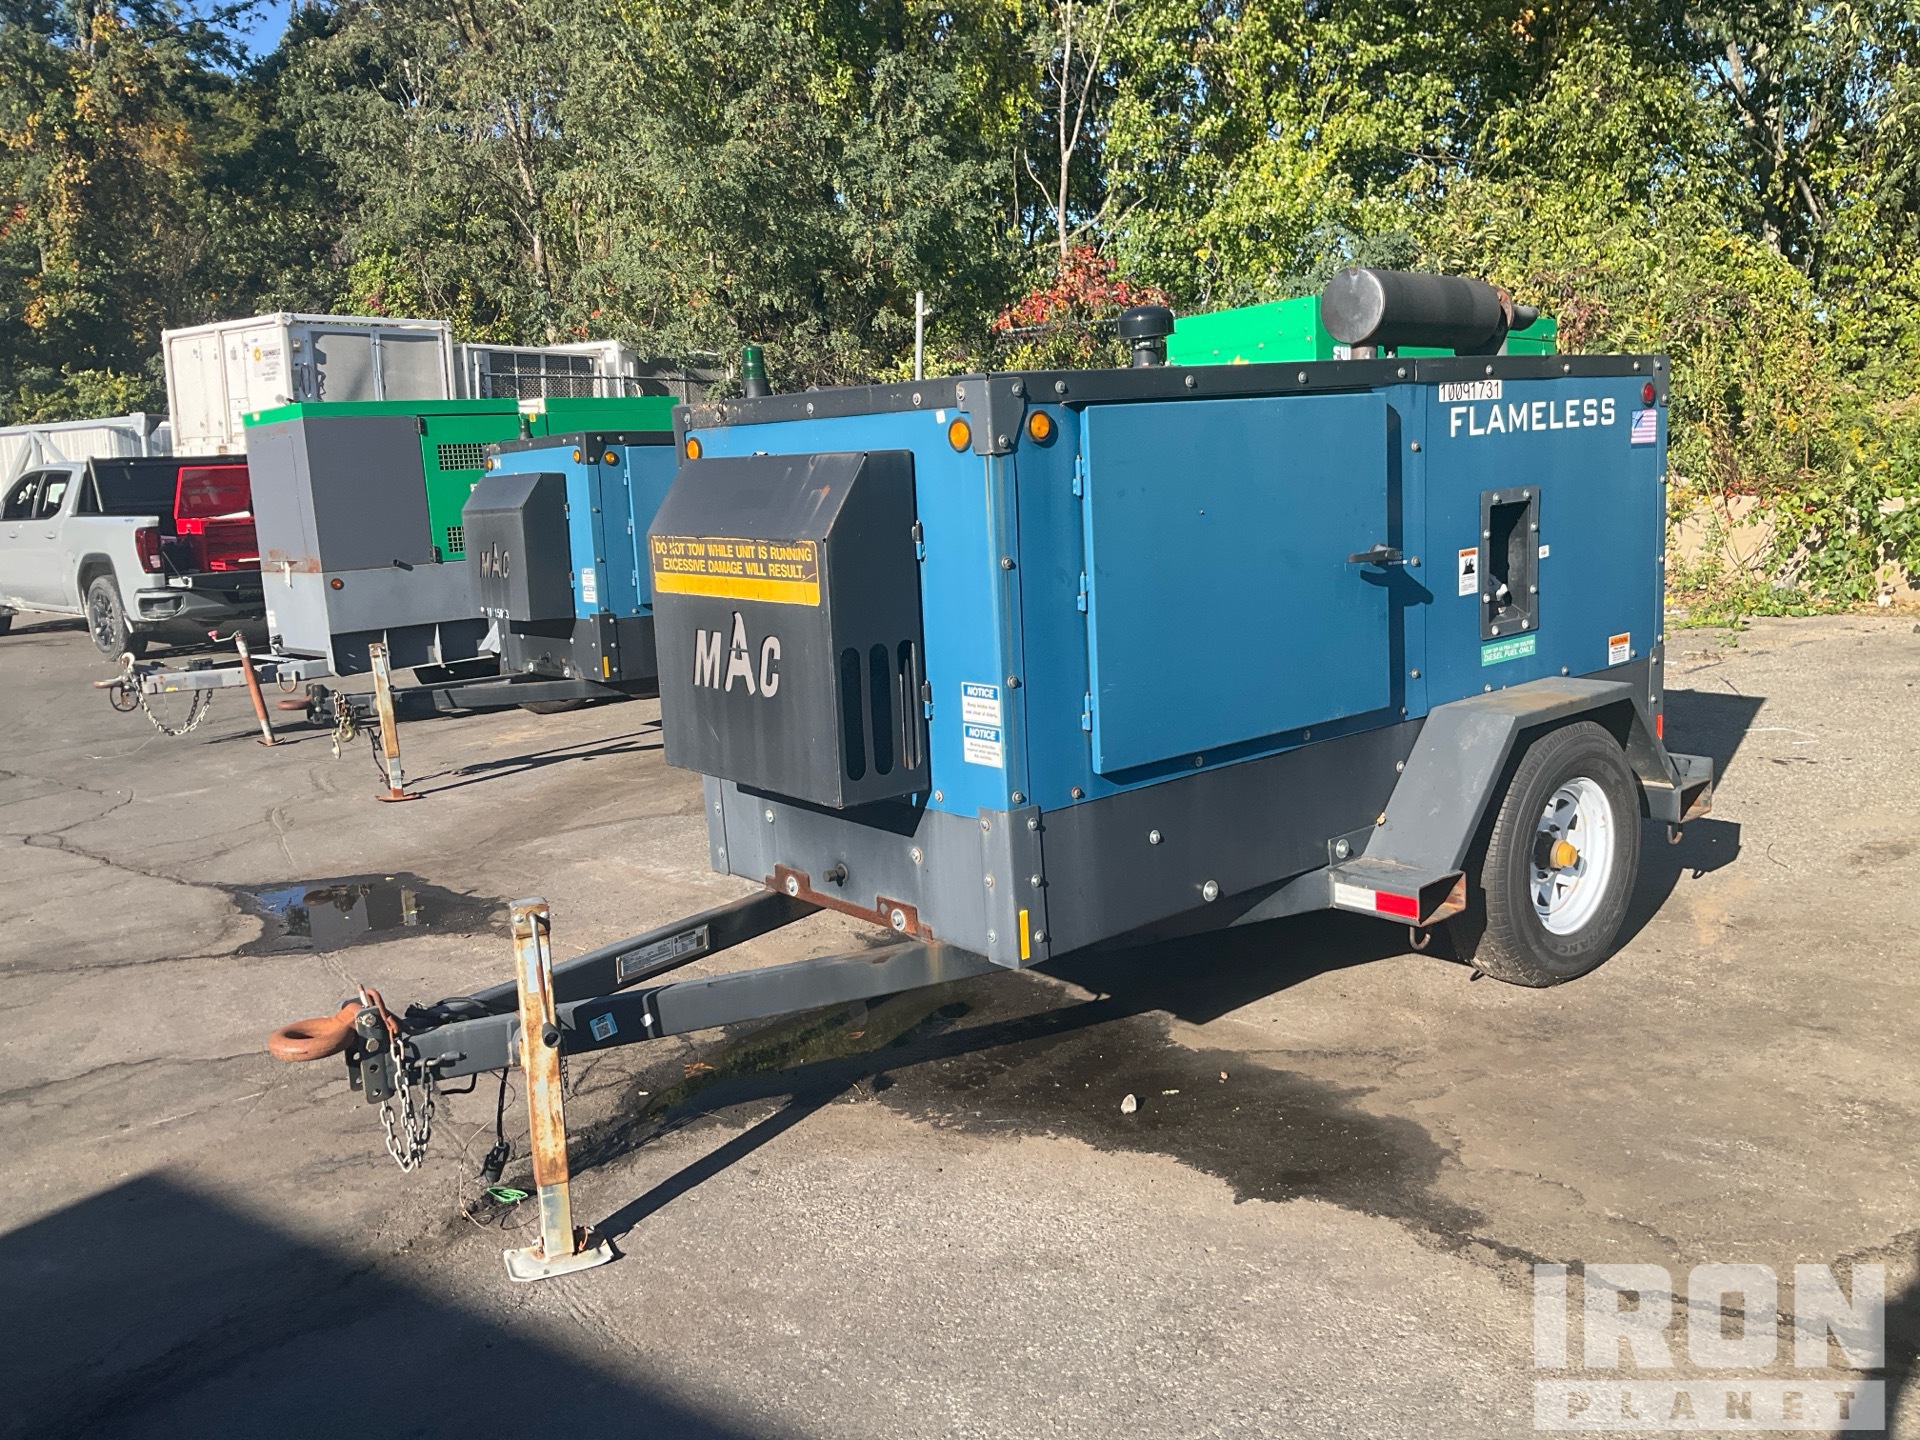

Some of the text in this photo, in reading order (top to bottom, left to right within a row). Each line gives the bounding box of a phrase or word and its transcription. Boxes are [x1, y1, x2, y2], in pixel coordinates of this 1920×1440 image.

[1440, 381, 1500, 401] 10091731
[1450, 398, 1615, 438] FLAMELESS
[480, 542, 510, 579] MAC
[655, 541, 812, 562] DO NOT TOW WHILE UNIT IS RUNNING
[663, 557, 806, 579] EXCESSIVE DAMAGE WILL RESULT.
[693, 611, 781, 698] MAC
[1484, 645, 1533, 662] DIESEL FUEL ONLY
[966, 686, 994, 698] NOTICE
[969, 727, 996, 740] NOTICE
